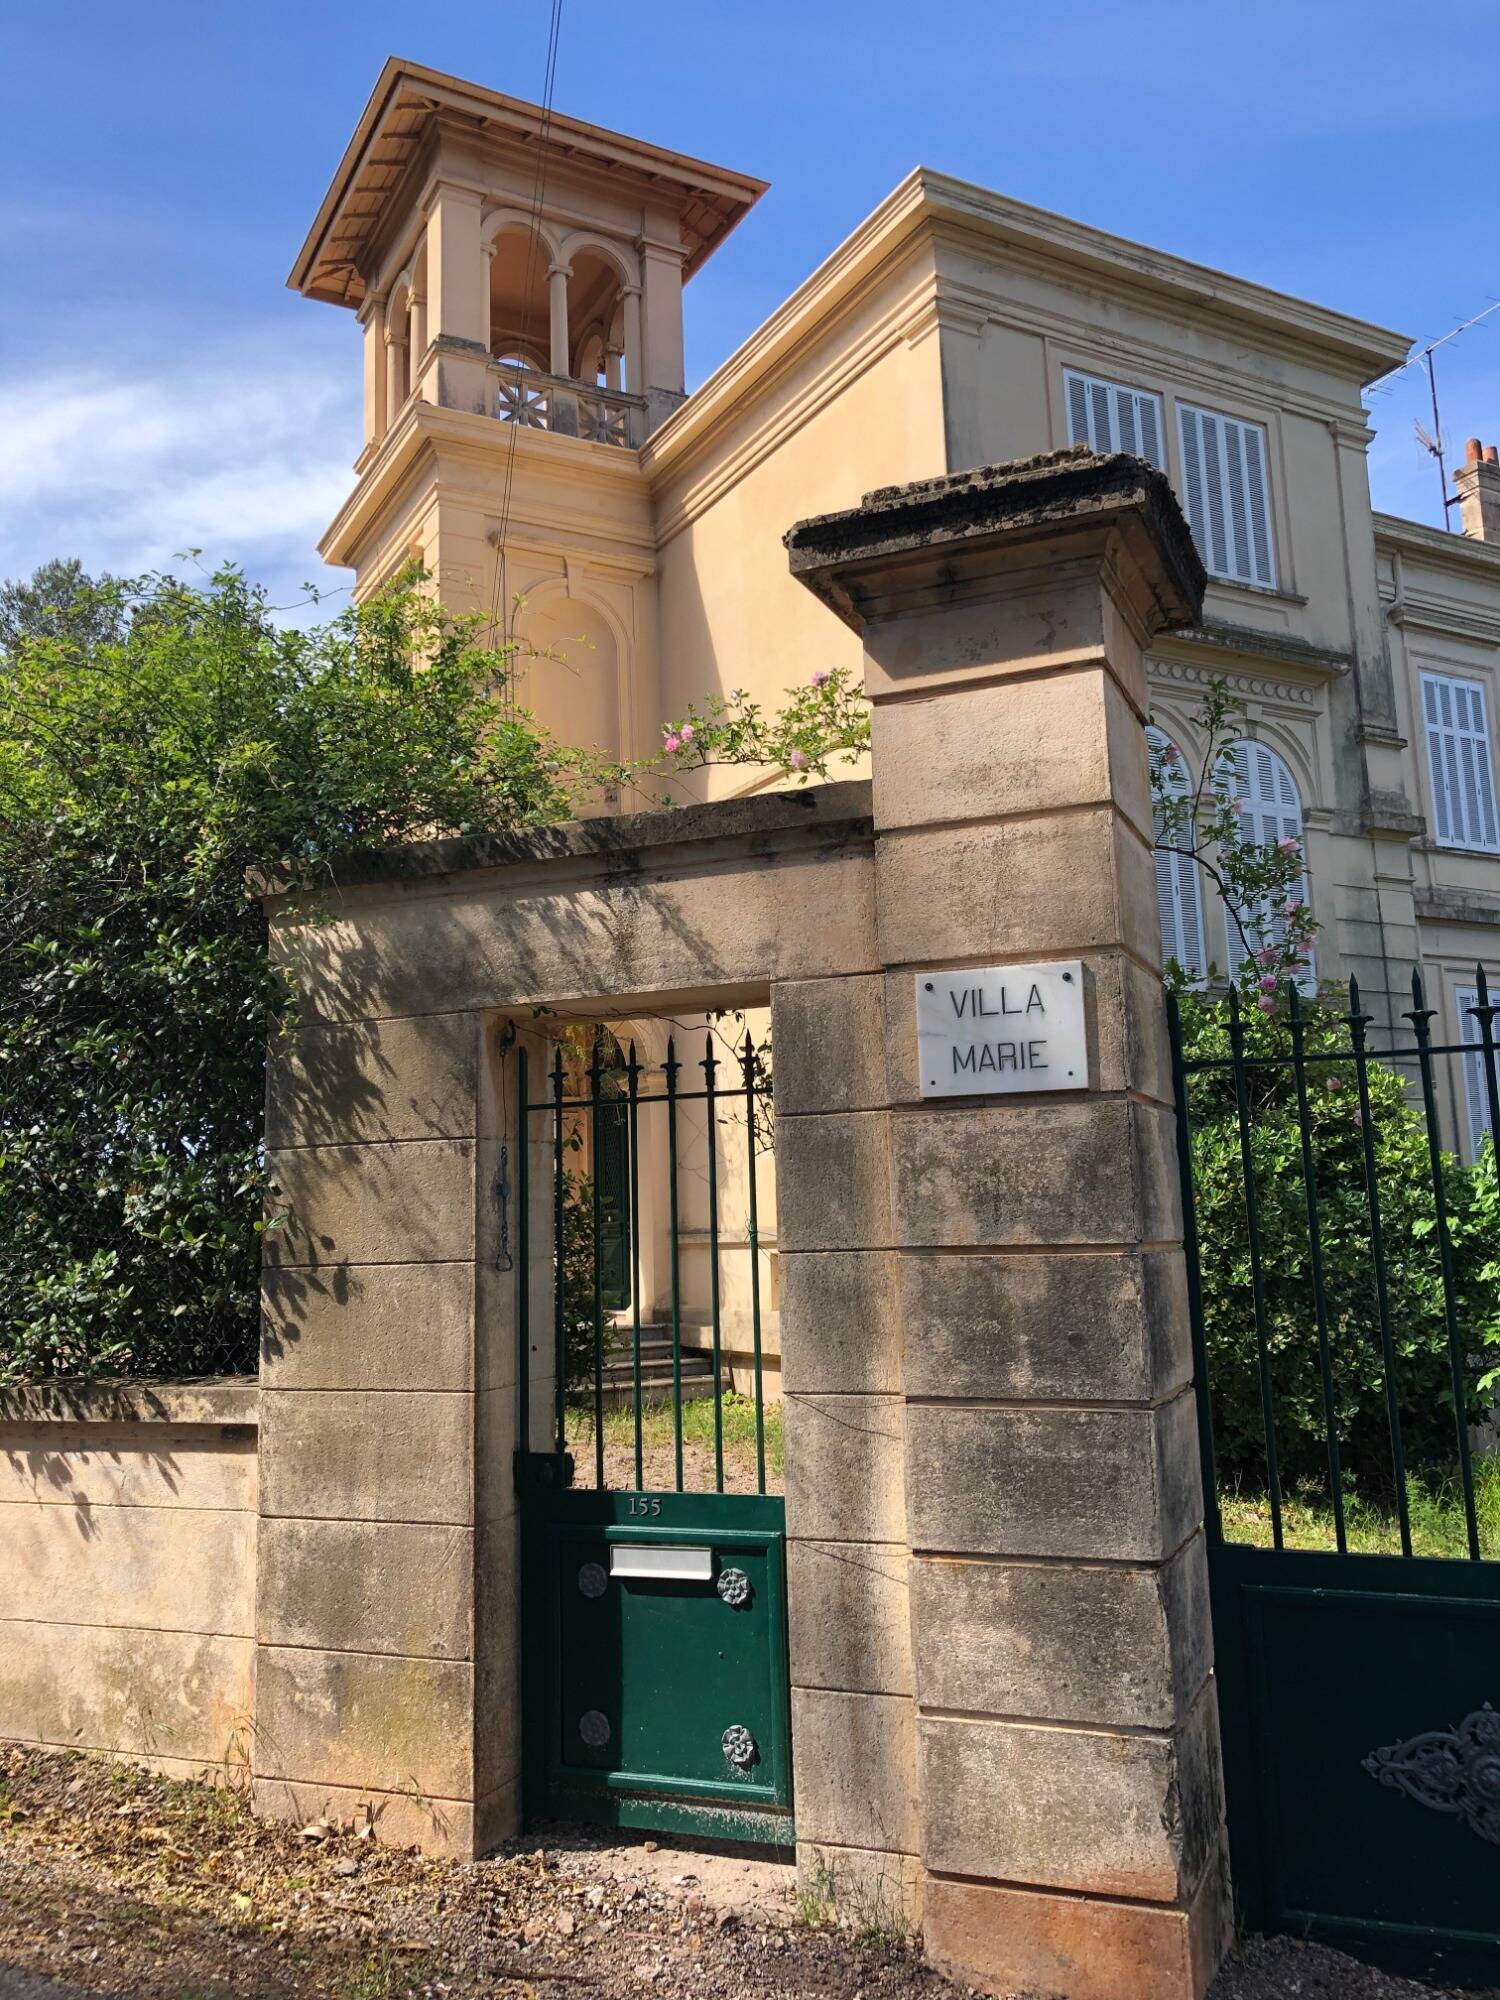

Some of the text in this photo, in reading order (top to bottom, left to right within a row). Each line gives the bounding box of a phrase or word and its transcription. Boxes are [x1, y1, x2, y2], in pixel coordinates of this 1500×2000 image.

[950, 984, 1045, 1018] VILLA
[953, 1040, 1049, 1074] MARIE
[628, 1497, 663, 1517] 155
